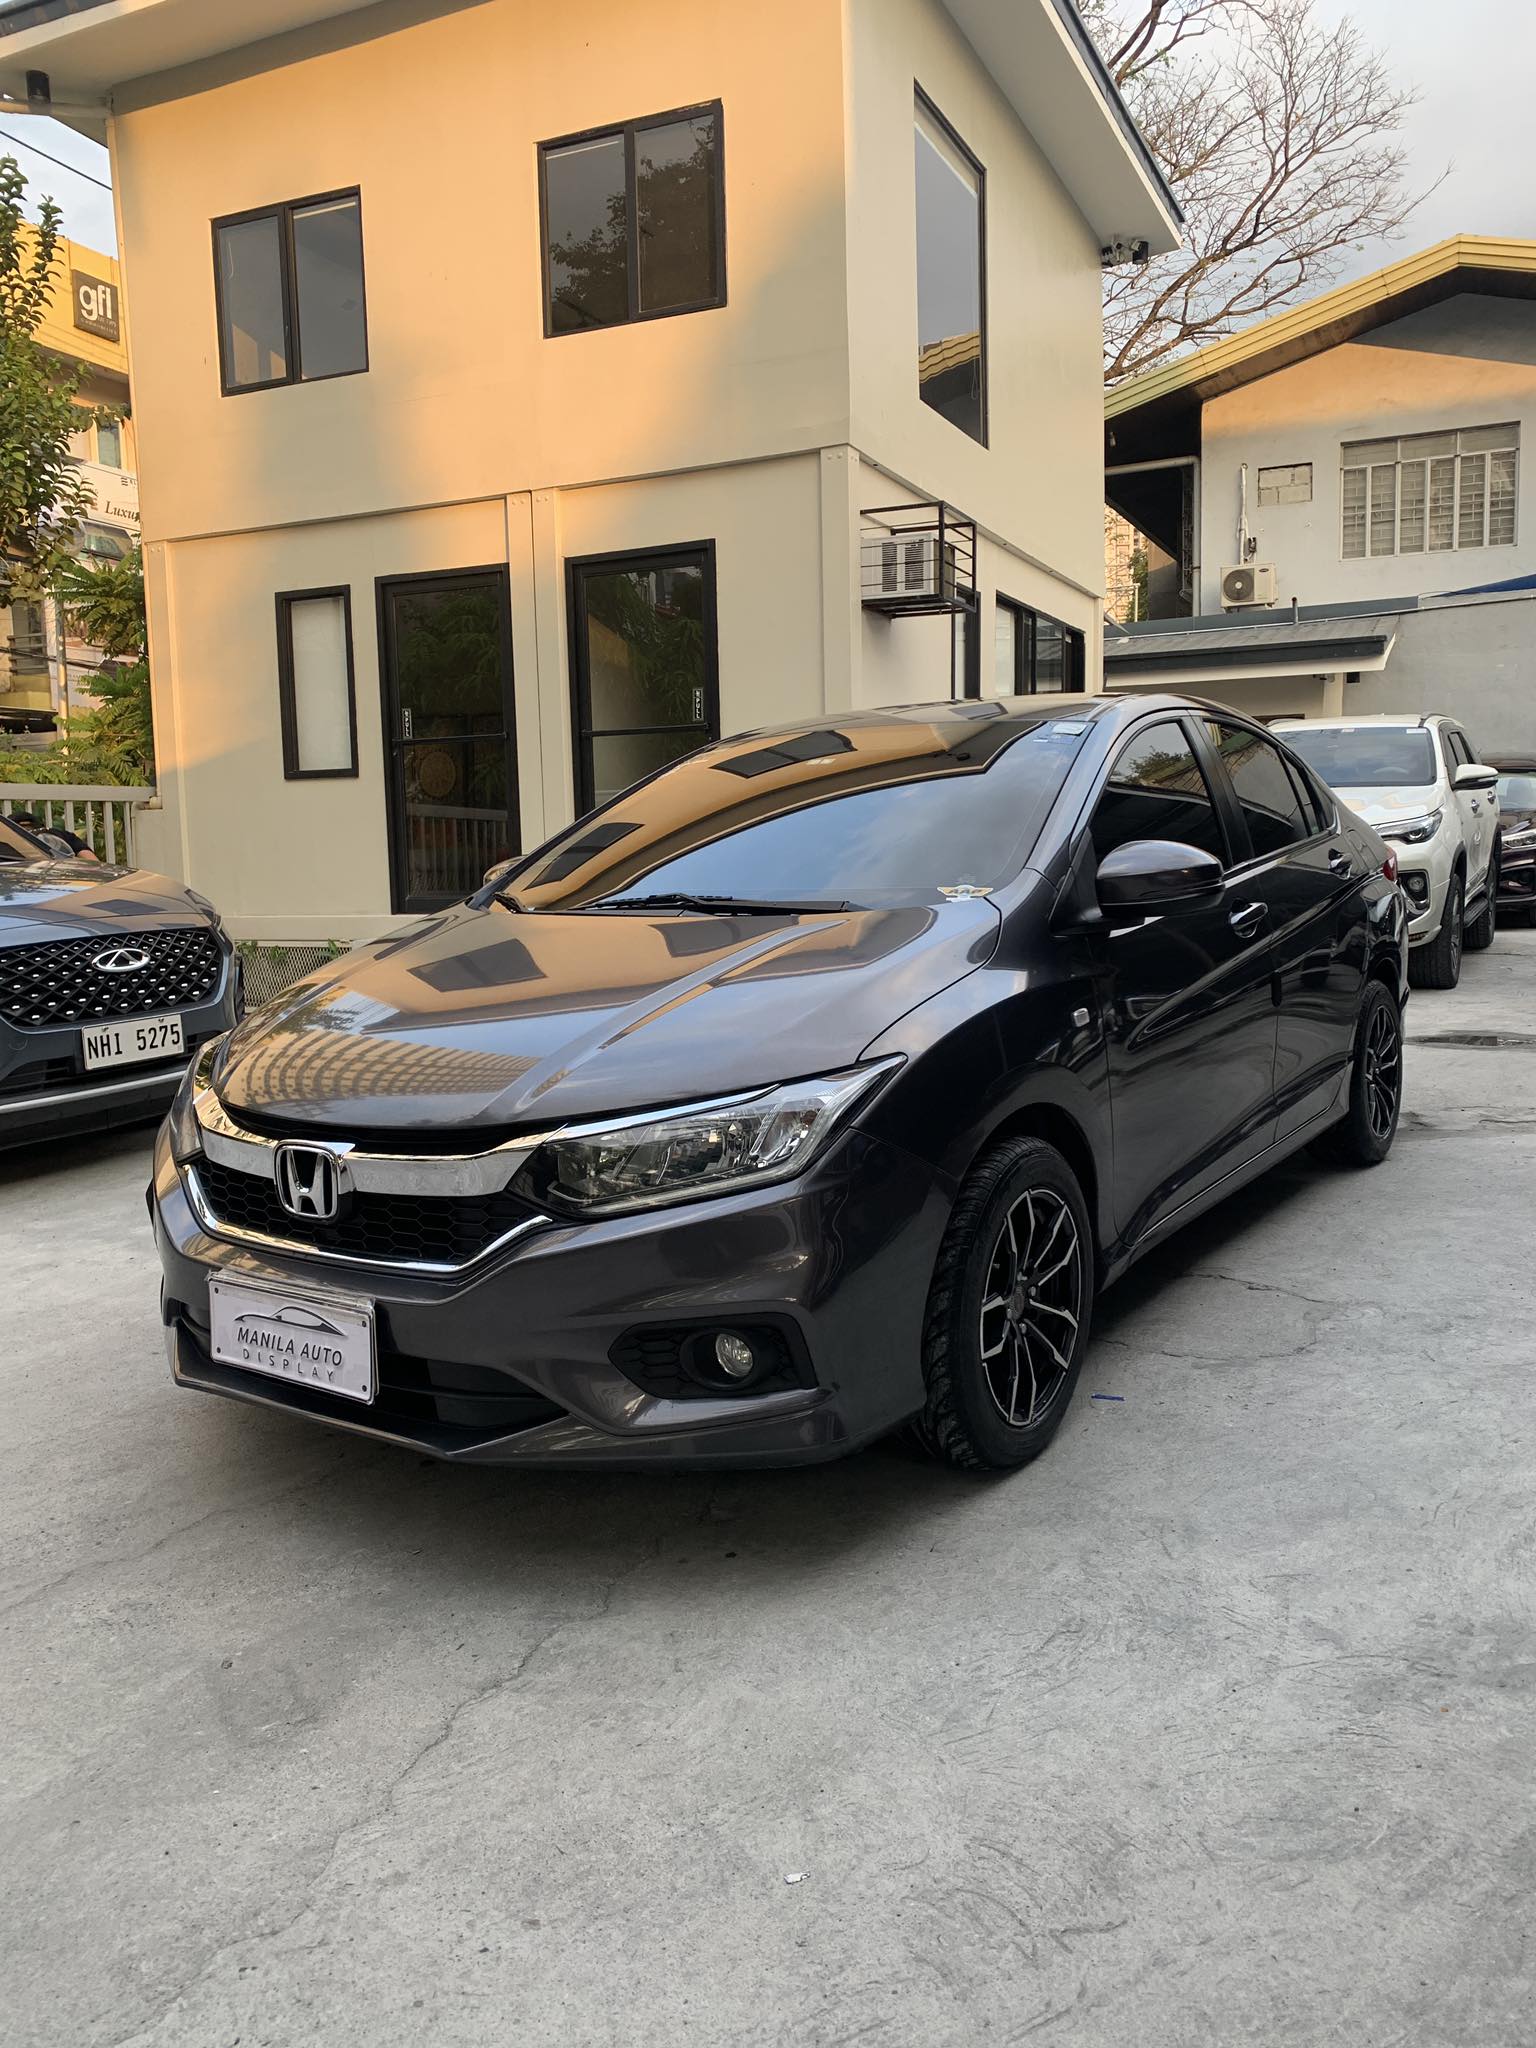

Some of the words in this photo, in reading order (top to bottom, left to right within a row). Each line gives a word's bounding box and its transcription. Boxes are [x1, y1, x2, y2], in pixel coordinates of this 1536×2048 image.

[105, 500, 139, 520] Luxu
[87, 1032, 123, 1059] NHI
[136, 1023, 181, 1051] 5275
[237, 1326, 295, 1355] MANILA
[300, 1342, 343, 1367] AUTO
[242, 1348, 336, 1382] DISPLAY
